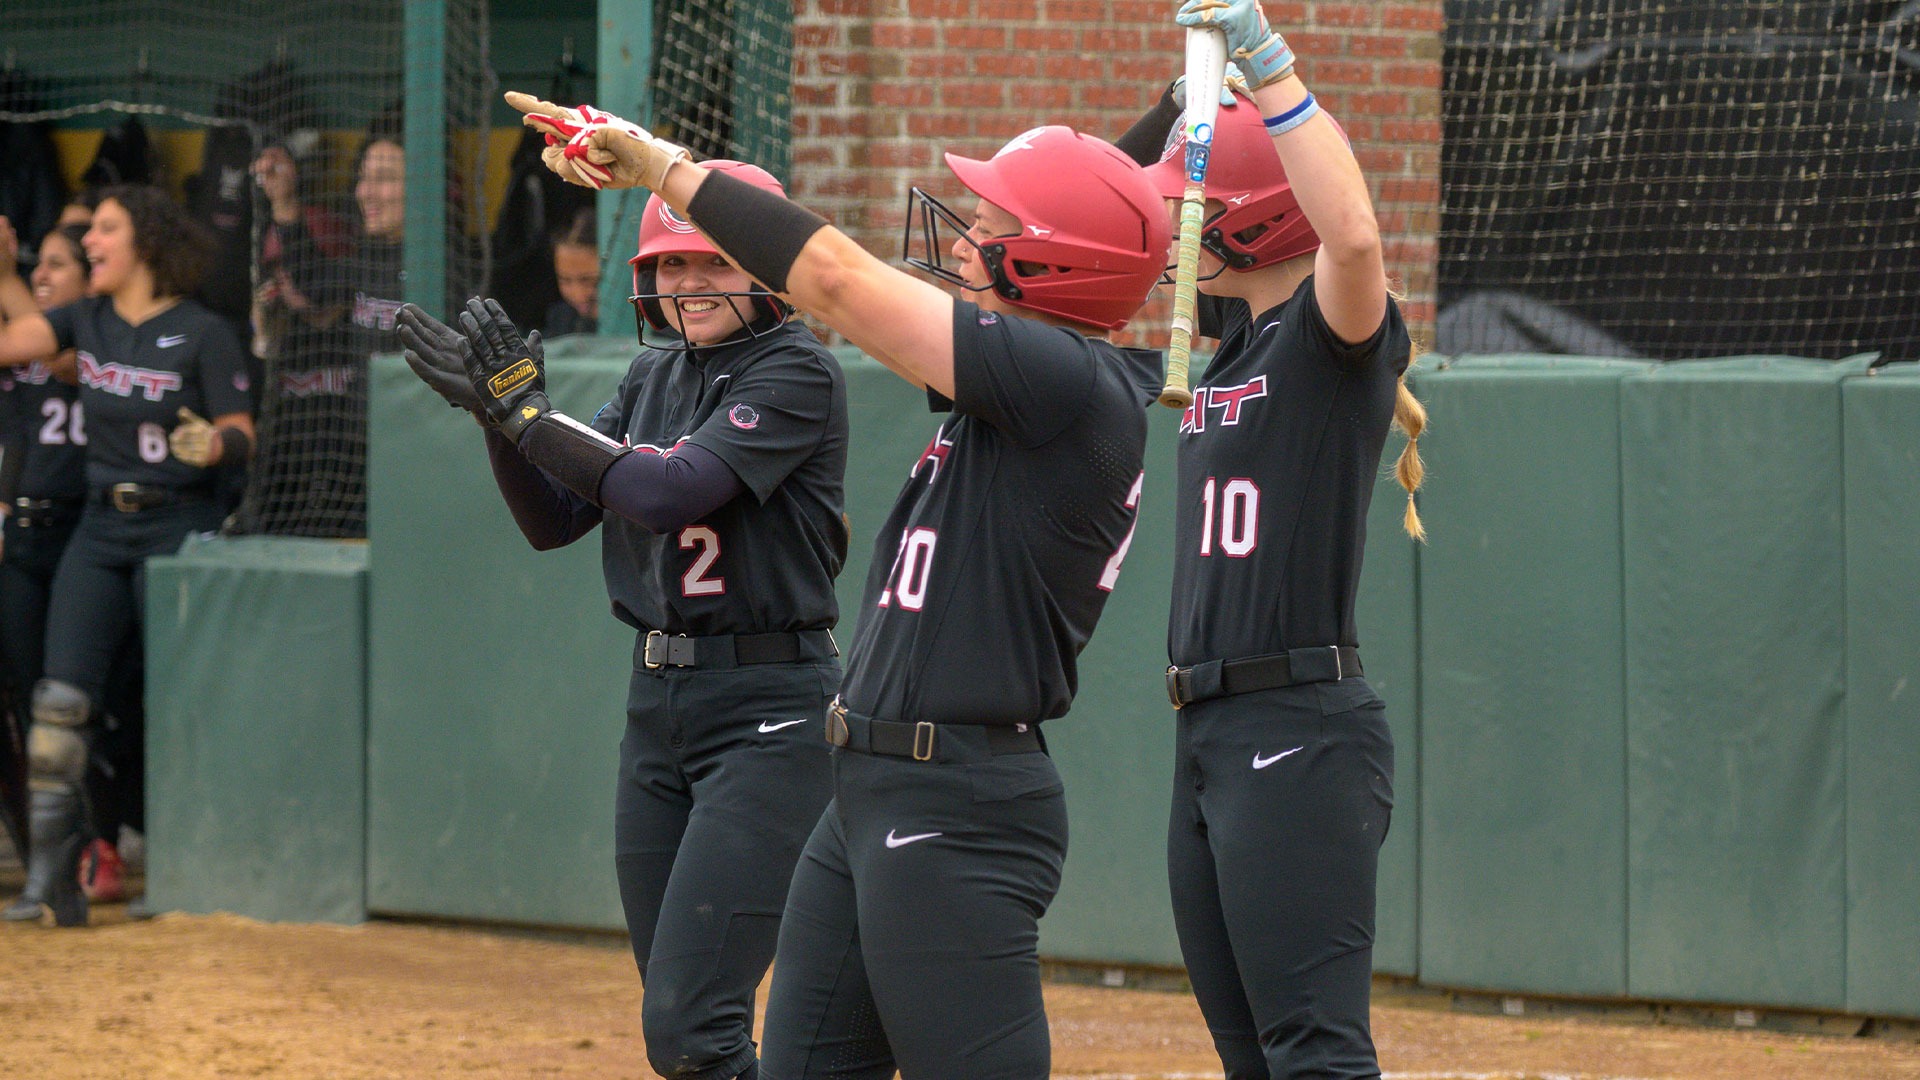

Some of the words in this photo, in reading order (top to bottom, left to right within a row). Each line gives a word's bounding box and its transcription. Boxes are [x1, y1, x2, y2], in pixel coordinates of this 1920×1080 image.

[77, 350, 183, 402] MIT
[493, 364, 534, 395] Franklin
[138, 421, 169, 463] 6
[1200, 476, 1261, 558] 10
[678, 525, 726, 597] 2
